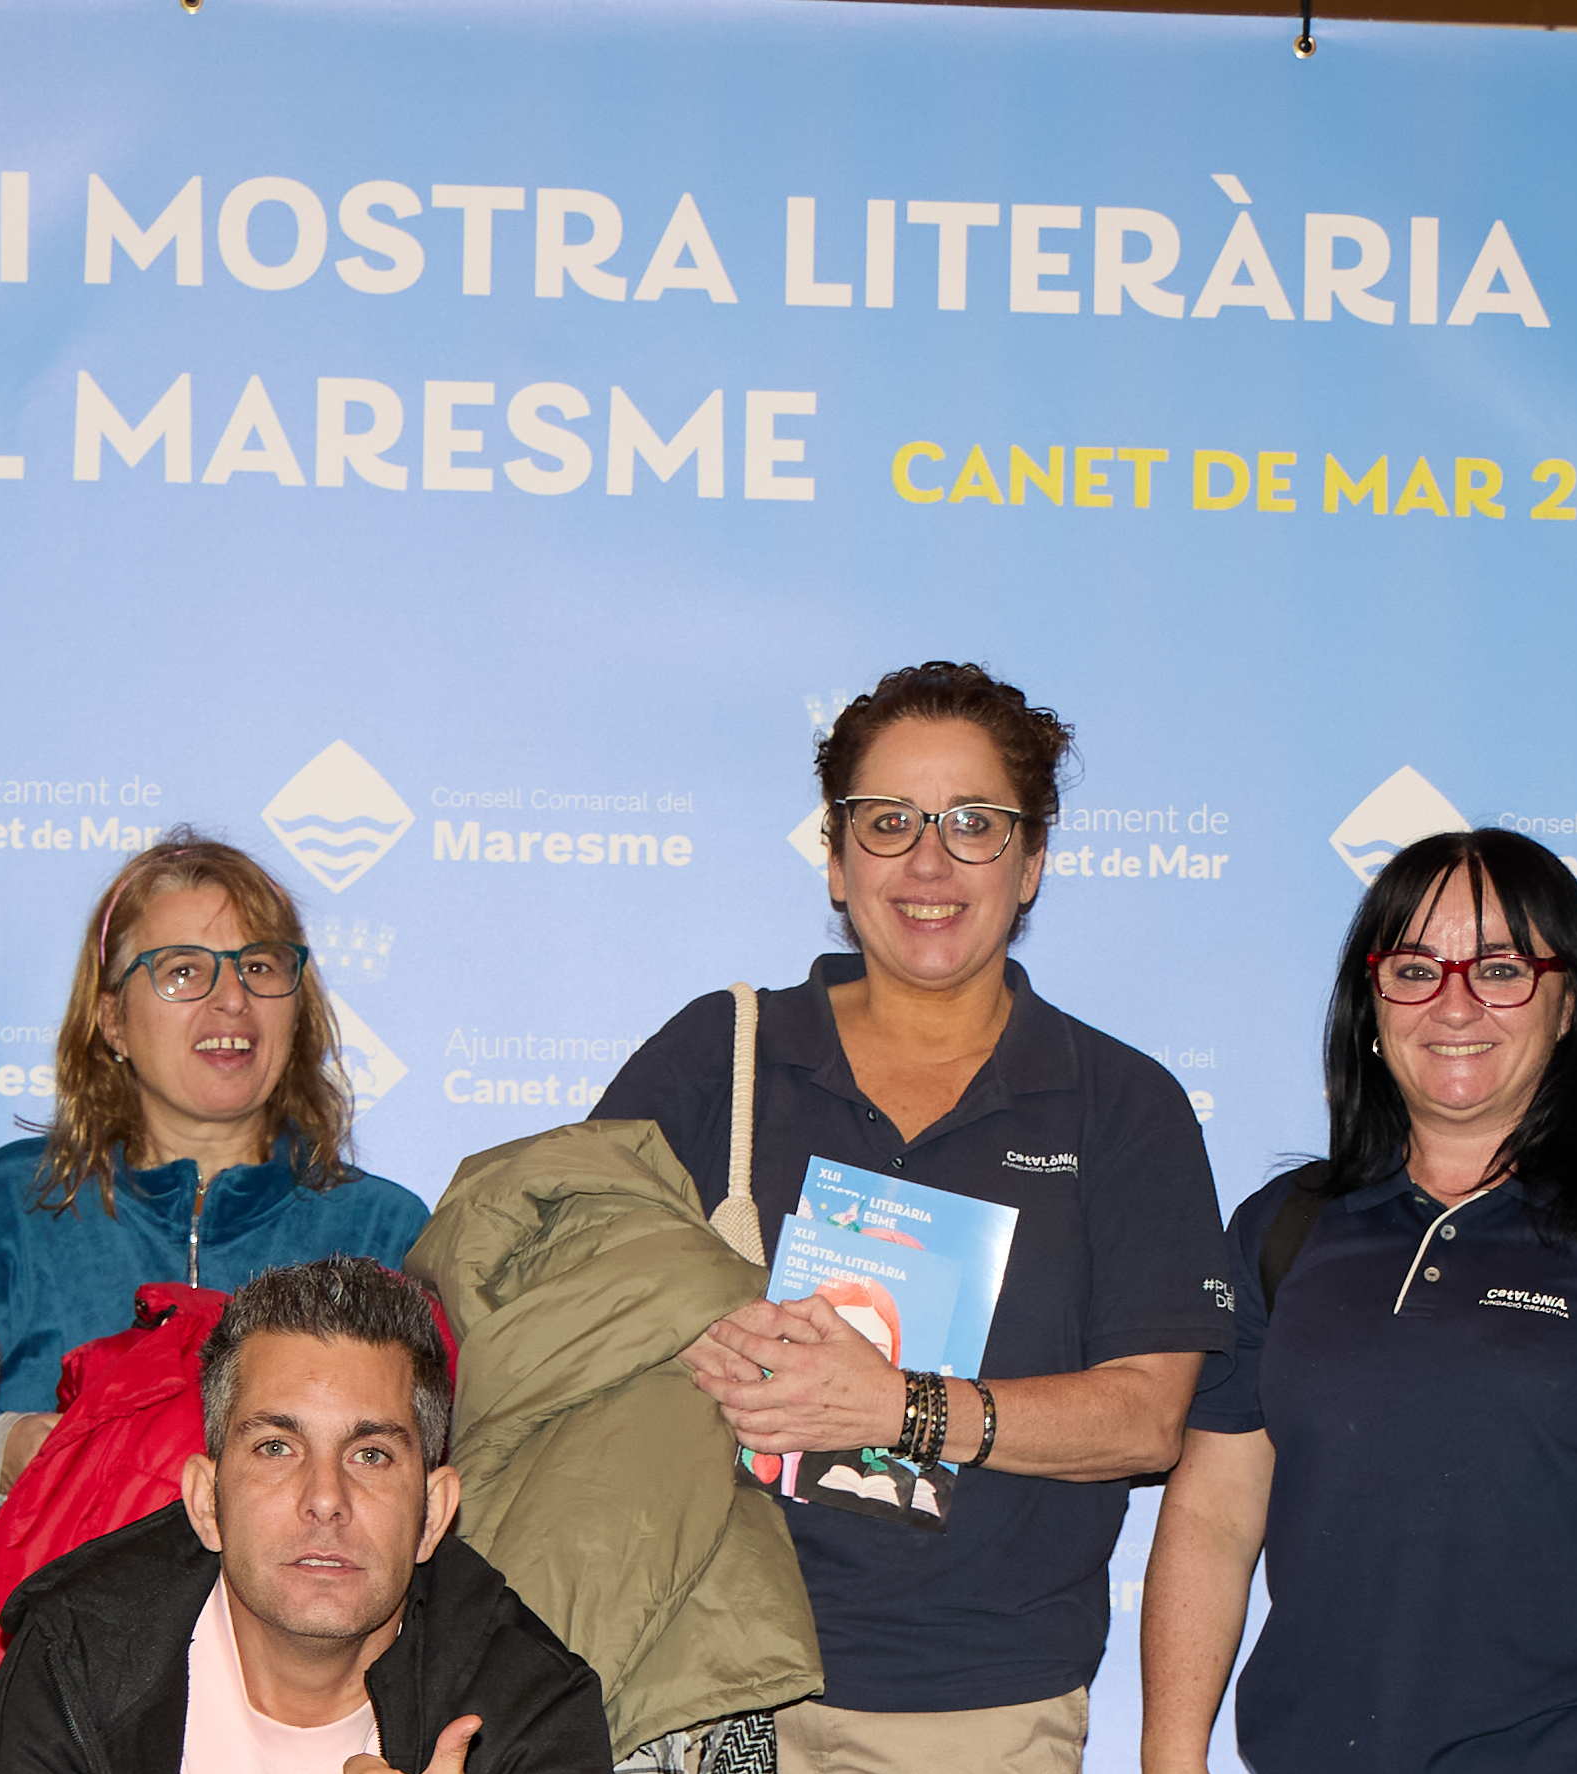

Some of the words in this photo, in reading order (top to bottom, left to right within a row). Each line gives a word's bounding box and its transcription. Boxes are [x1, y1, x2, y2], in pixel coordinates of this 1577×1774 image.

[84, 172, 739, 304] MOSTRA
[784, 173, 1551, 328] LITERÀRIA
[73, 369, 818, 501] MARESME
[890, 440, 1170, 511] CANET
[1192, 449, 1298, 514] DE
[1323, 453, 1506, 521] MAR
[119, 775, 162, 807] de
[431, 785, 524, 810] Consell
[530, 788, 649, 812] Comarcal
[656, 791, 695, 814] del
[31, 819, 73, 850] de
[80, 816, 162, 851] Mar
[1060, 802, 1179, 834] tament
[1188, 803, 1230, 835] de
[433, 820, 694, 867] Maresme
[1100, 847, 1142, 878] de
[1148, 843, 1229, 879] Mar
[1178, 1046, 1216, 1069] del
[443, 1069, 561, 1106] Canet
[818, 1167, 842, 1183] XLII
[863, 1211, 898, 1229] ESME
[869, 1197, 932, 1224] LITERÀRIA
[793, 1226, 817, 1241] XLII
[784, 1269, 810, 1282] CANET
[786, 1255, 809, 1272] DEL
[811, 1262, 873, 1289] MARESME
[789, 1241, 843, 1265] MOSTRA
[844, 1255, 907, 1281] LITERÀRIA
[782, 1278, 803, 1291] 2025
